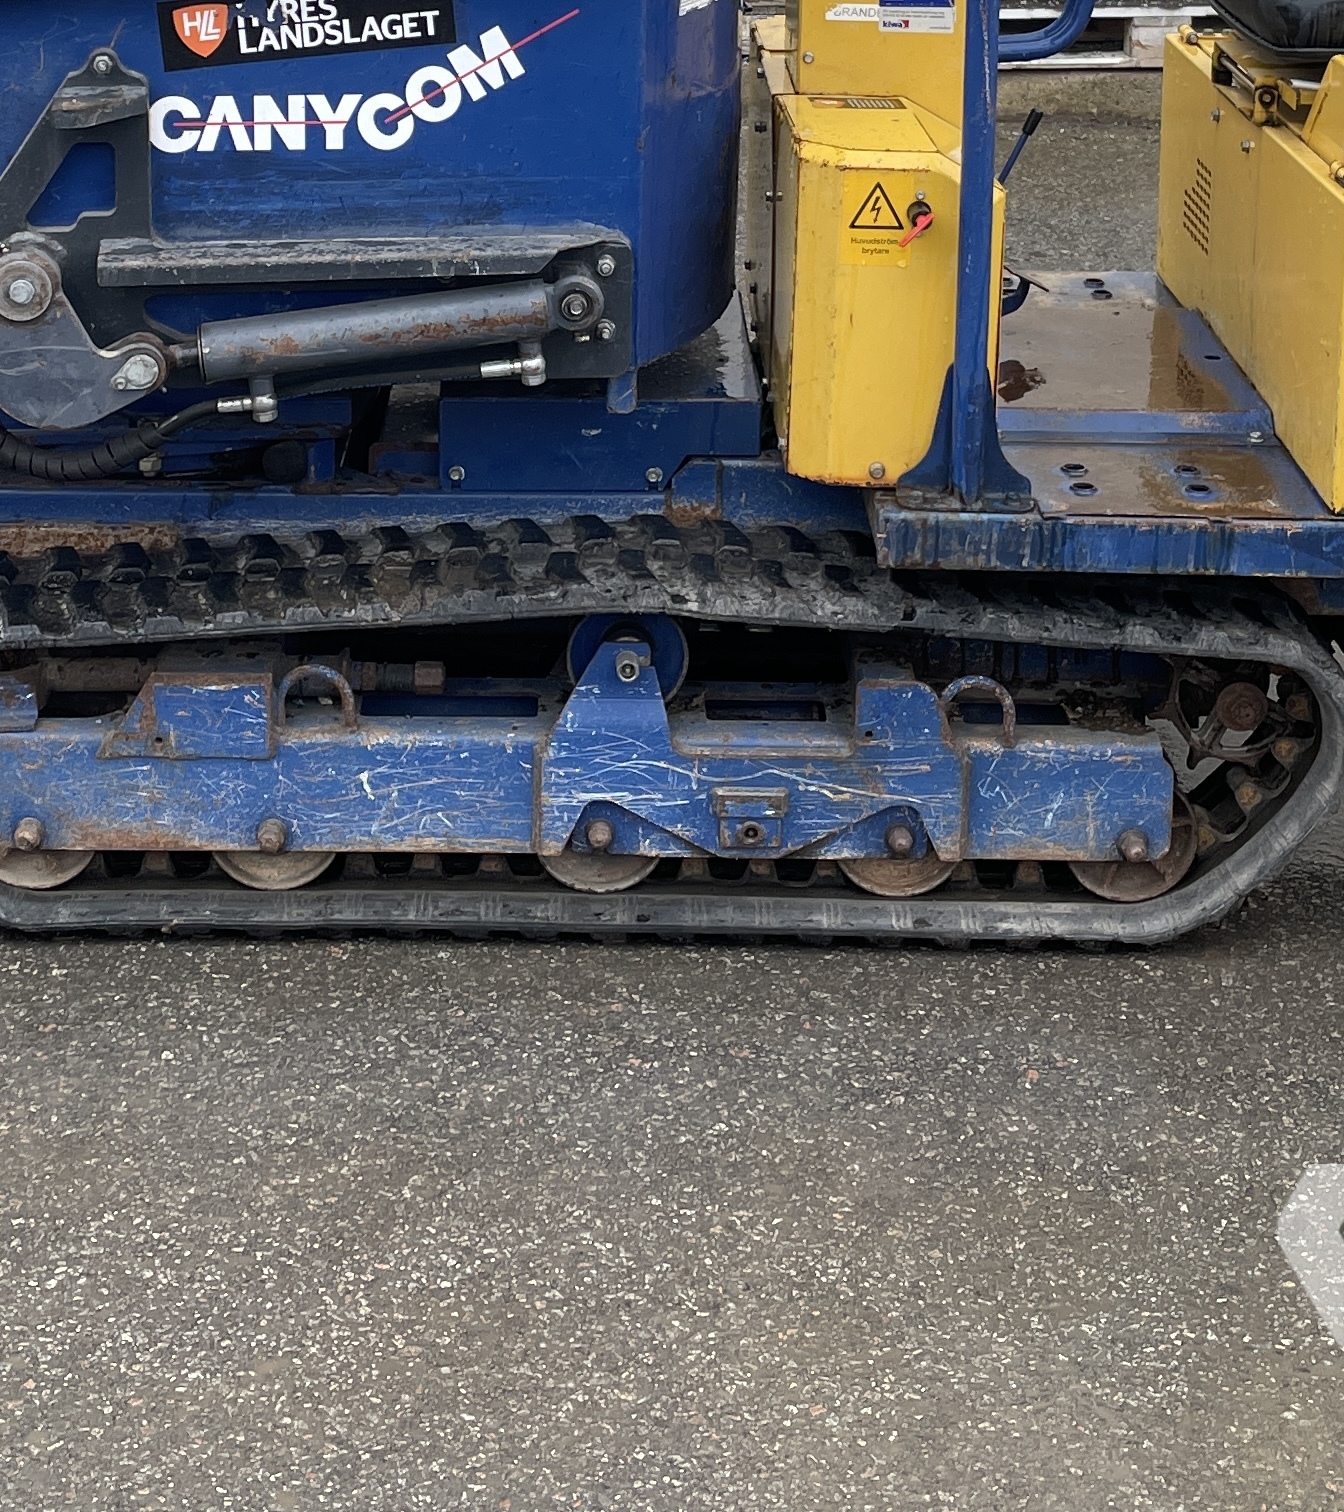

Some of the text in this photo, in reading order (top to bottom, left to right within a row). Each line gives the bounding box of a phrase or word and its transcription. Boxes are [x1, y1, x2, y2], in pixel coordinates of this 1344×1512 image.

[238, 9, 440, 55] LANDSLAGET
[883, 20, 903, 29] kiwa
[148, 25, 526, 154] CANYCOM
